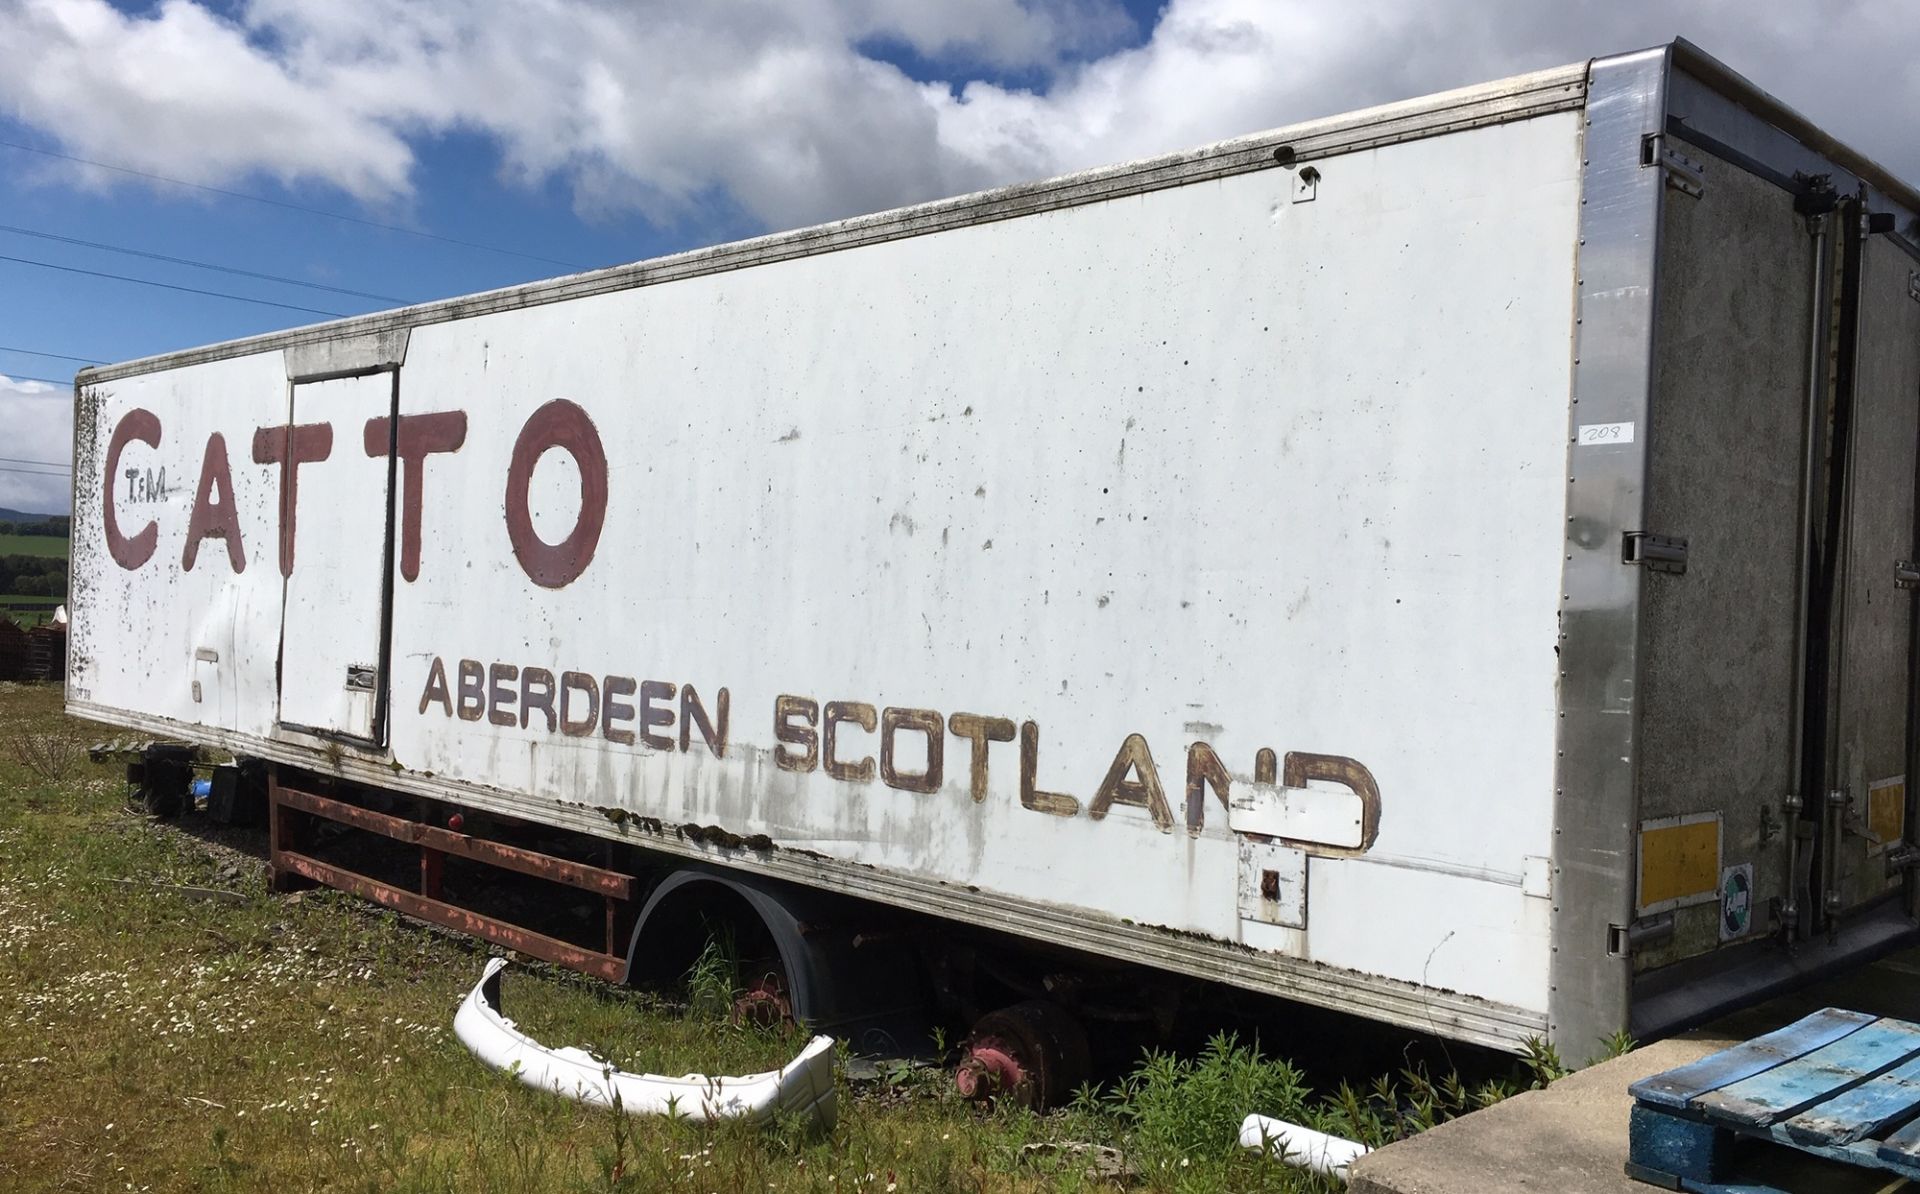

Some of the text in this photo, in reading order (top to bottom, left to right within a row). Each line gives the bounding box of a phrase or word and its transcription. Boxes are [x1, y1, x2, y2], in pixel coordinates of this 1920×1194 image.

[1583, 426, 1622, 441] 208
[103, 398, 609, 589] CATTO
[418, 655, 731, 760] ABERDEEN
